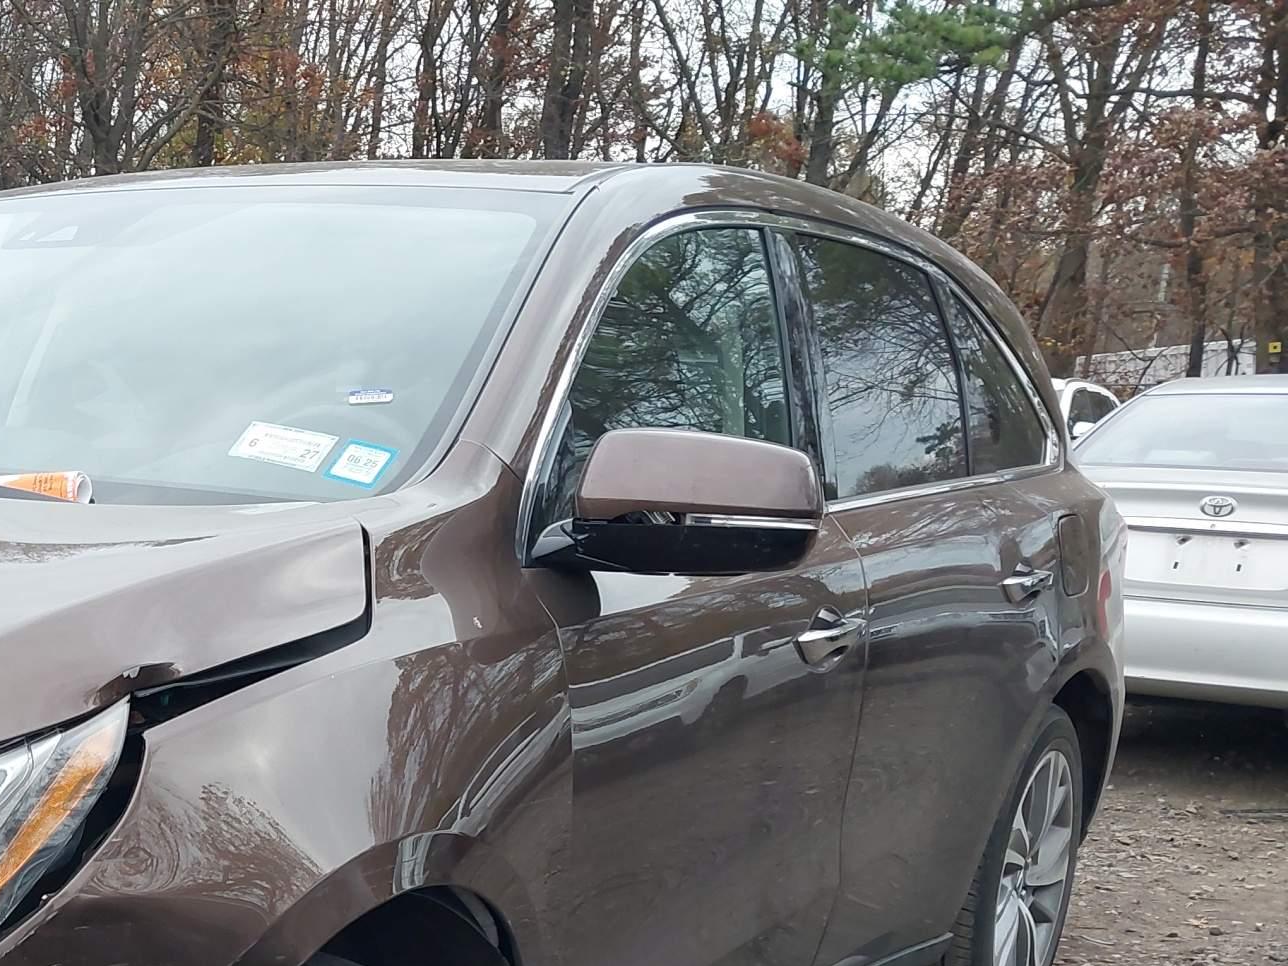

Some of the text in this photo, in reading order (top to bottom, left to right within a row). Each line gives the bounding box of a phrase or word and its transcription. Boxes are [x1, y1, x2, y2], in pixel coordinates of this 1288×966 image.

[248, 438, 260, 448] 6
[299, 448, 320, 460] 27
[363, 458, 379, 468] 25
